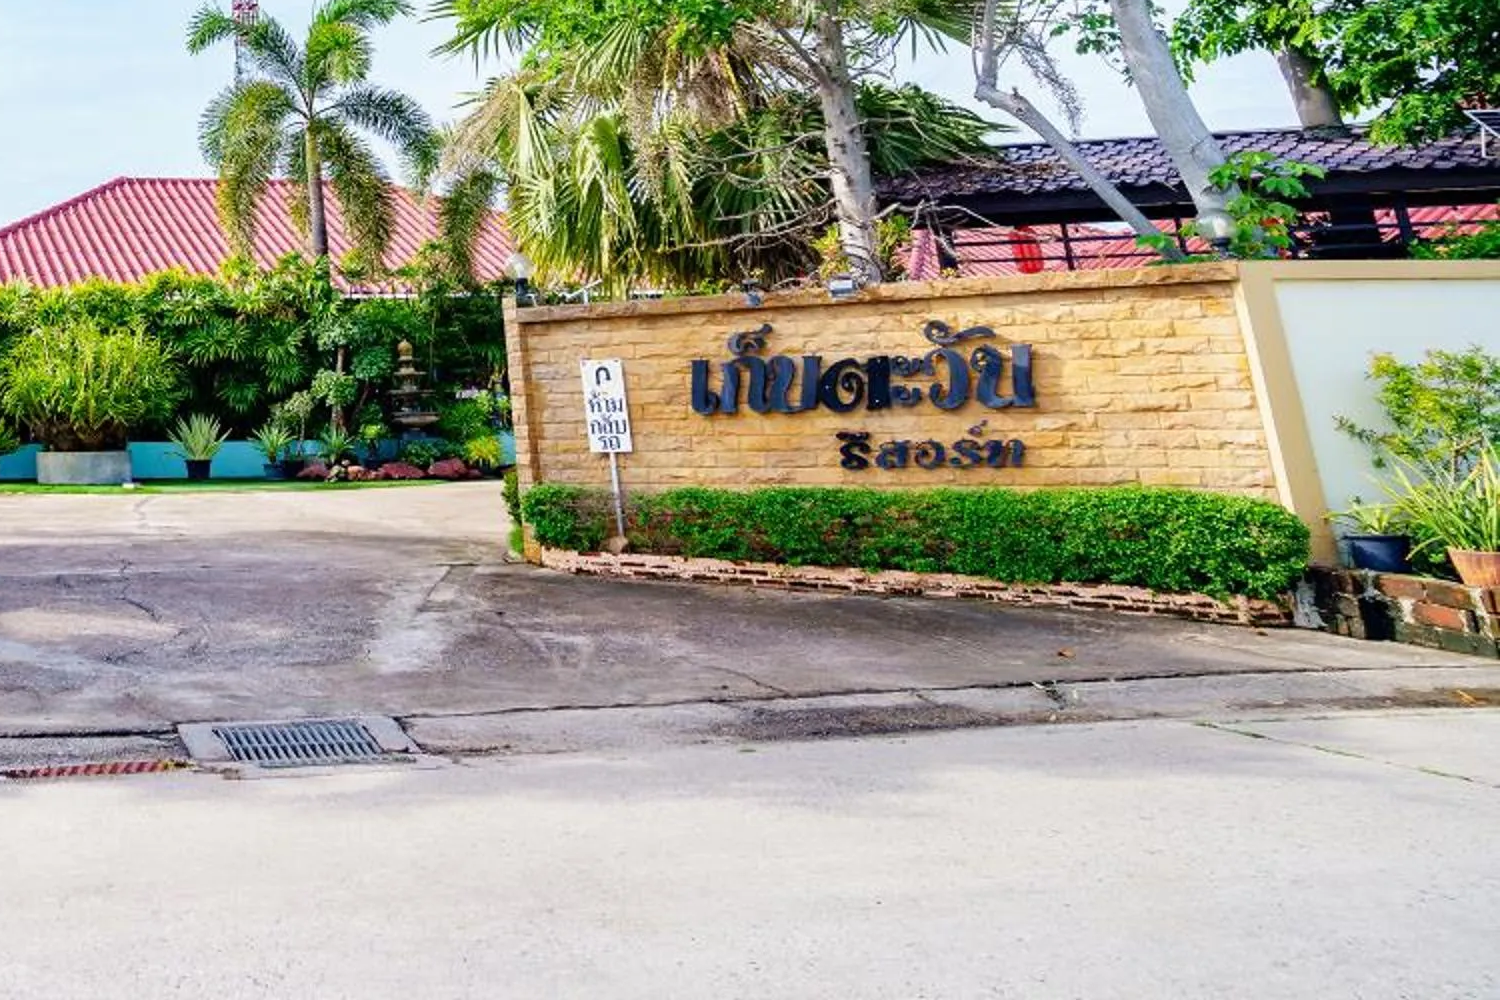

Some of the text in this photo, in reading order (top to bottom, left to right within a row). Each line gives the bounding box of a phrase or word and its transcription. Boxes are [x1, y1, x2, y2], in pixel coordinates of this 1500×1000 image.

[691, 319, 1035, 415] เก็บตะวัน
[835, 420, 1026, 470] รีสอร์ท
